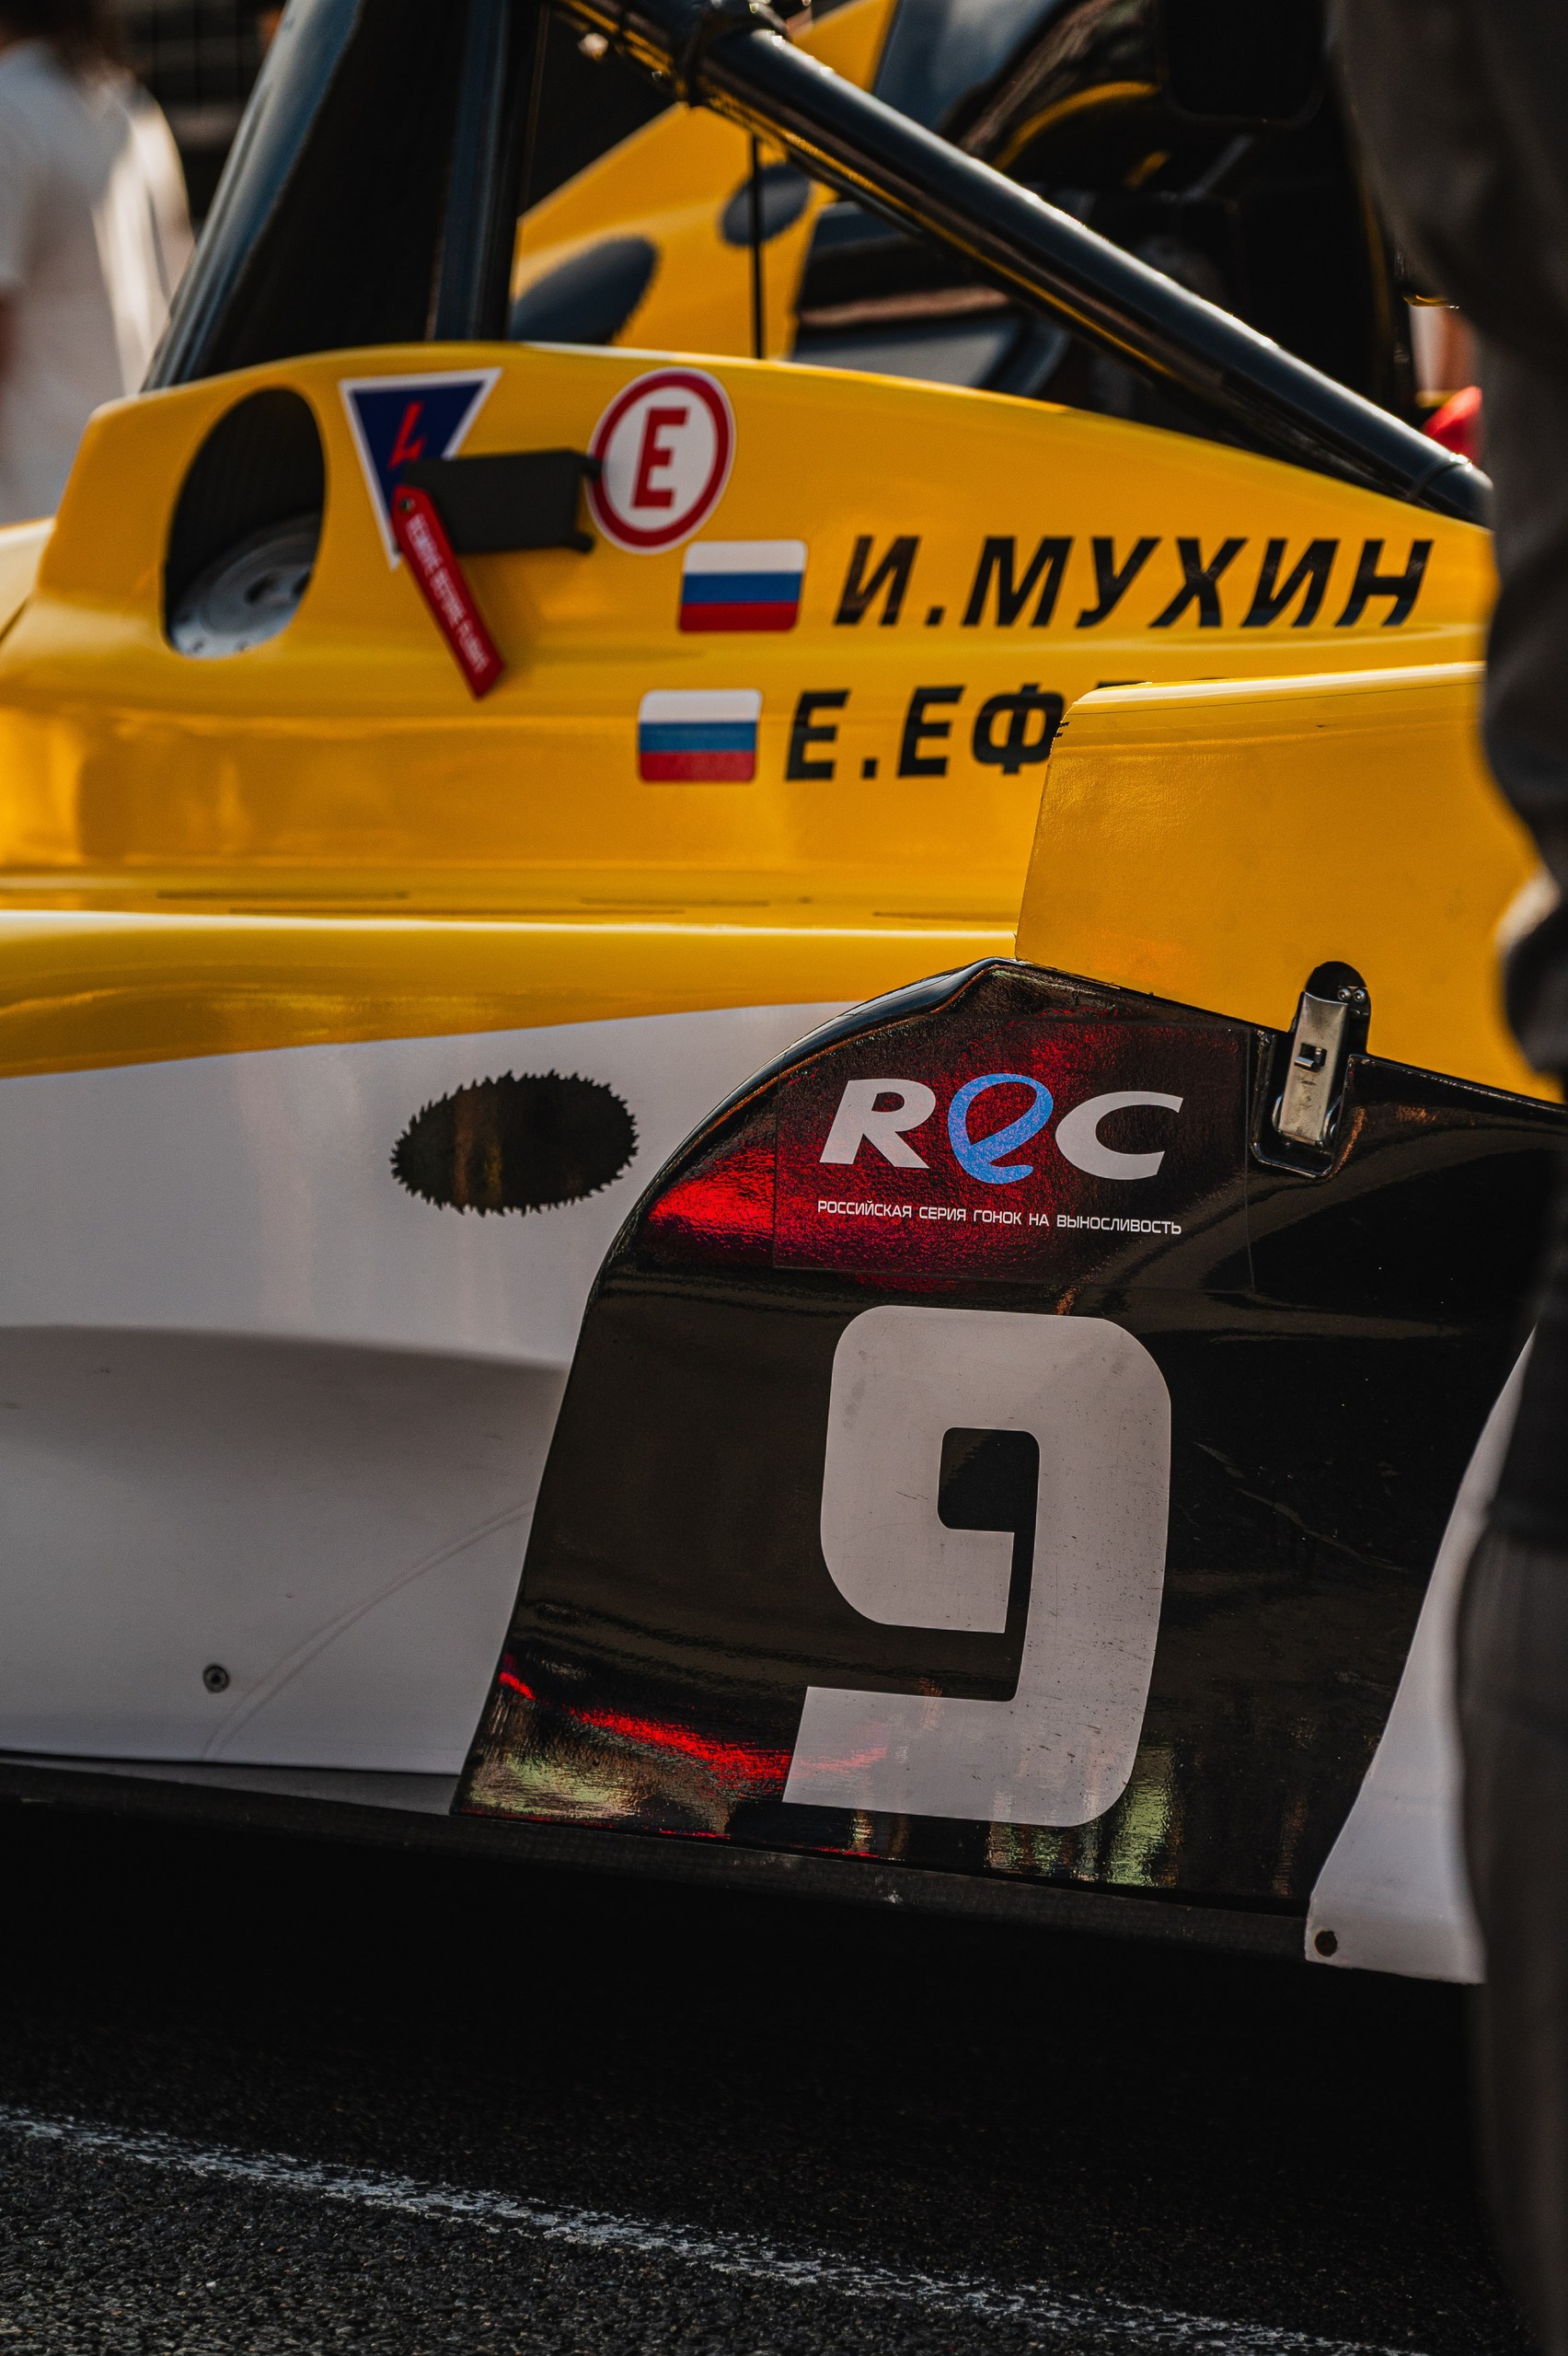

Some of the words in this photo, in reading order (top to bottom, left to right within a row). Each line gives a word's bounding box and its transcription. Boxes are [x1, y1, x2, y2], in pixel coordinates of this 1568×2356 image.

[631, 406, 691, 508] E
[833, 535, 1434, 629] И.МУХИН
[785, 682, 1150, 782] Е.ЕФ
[817, 1200, 912, 1218] РОССИЙСКАЯ
[918, 1206, 967, 1221] СЕРИЯ
[973, 1209, 1022, 1225] ГОНОК
[1029, 1213, 1050, 1227] НА
[1056, 1214, 1182, 1235] ВЫНОСЛИВОСТЬ
[782, 1305, 1171, 1827] 9
